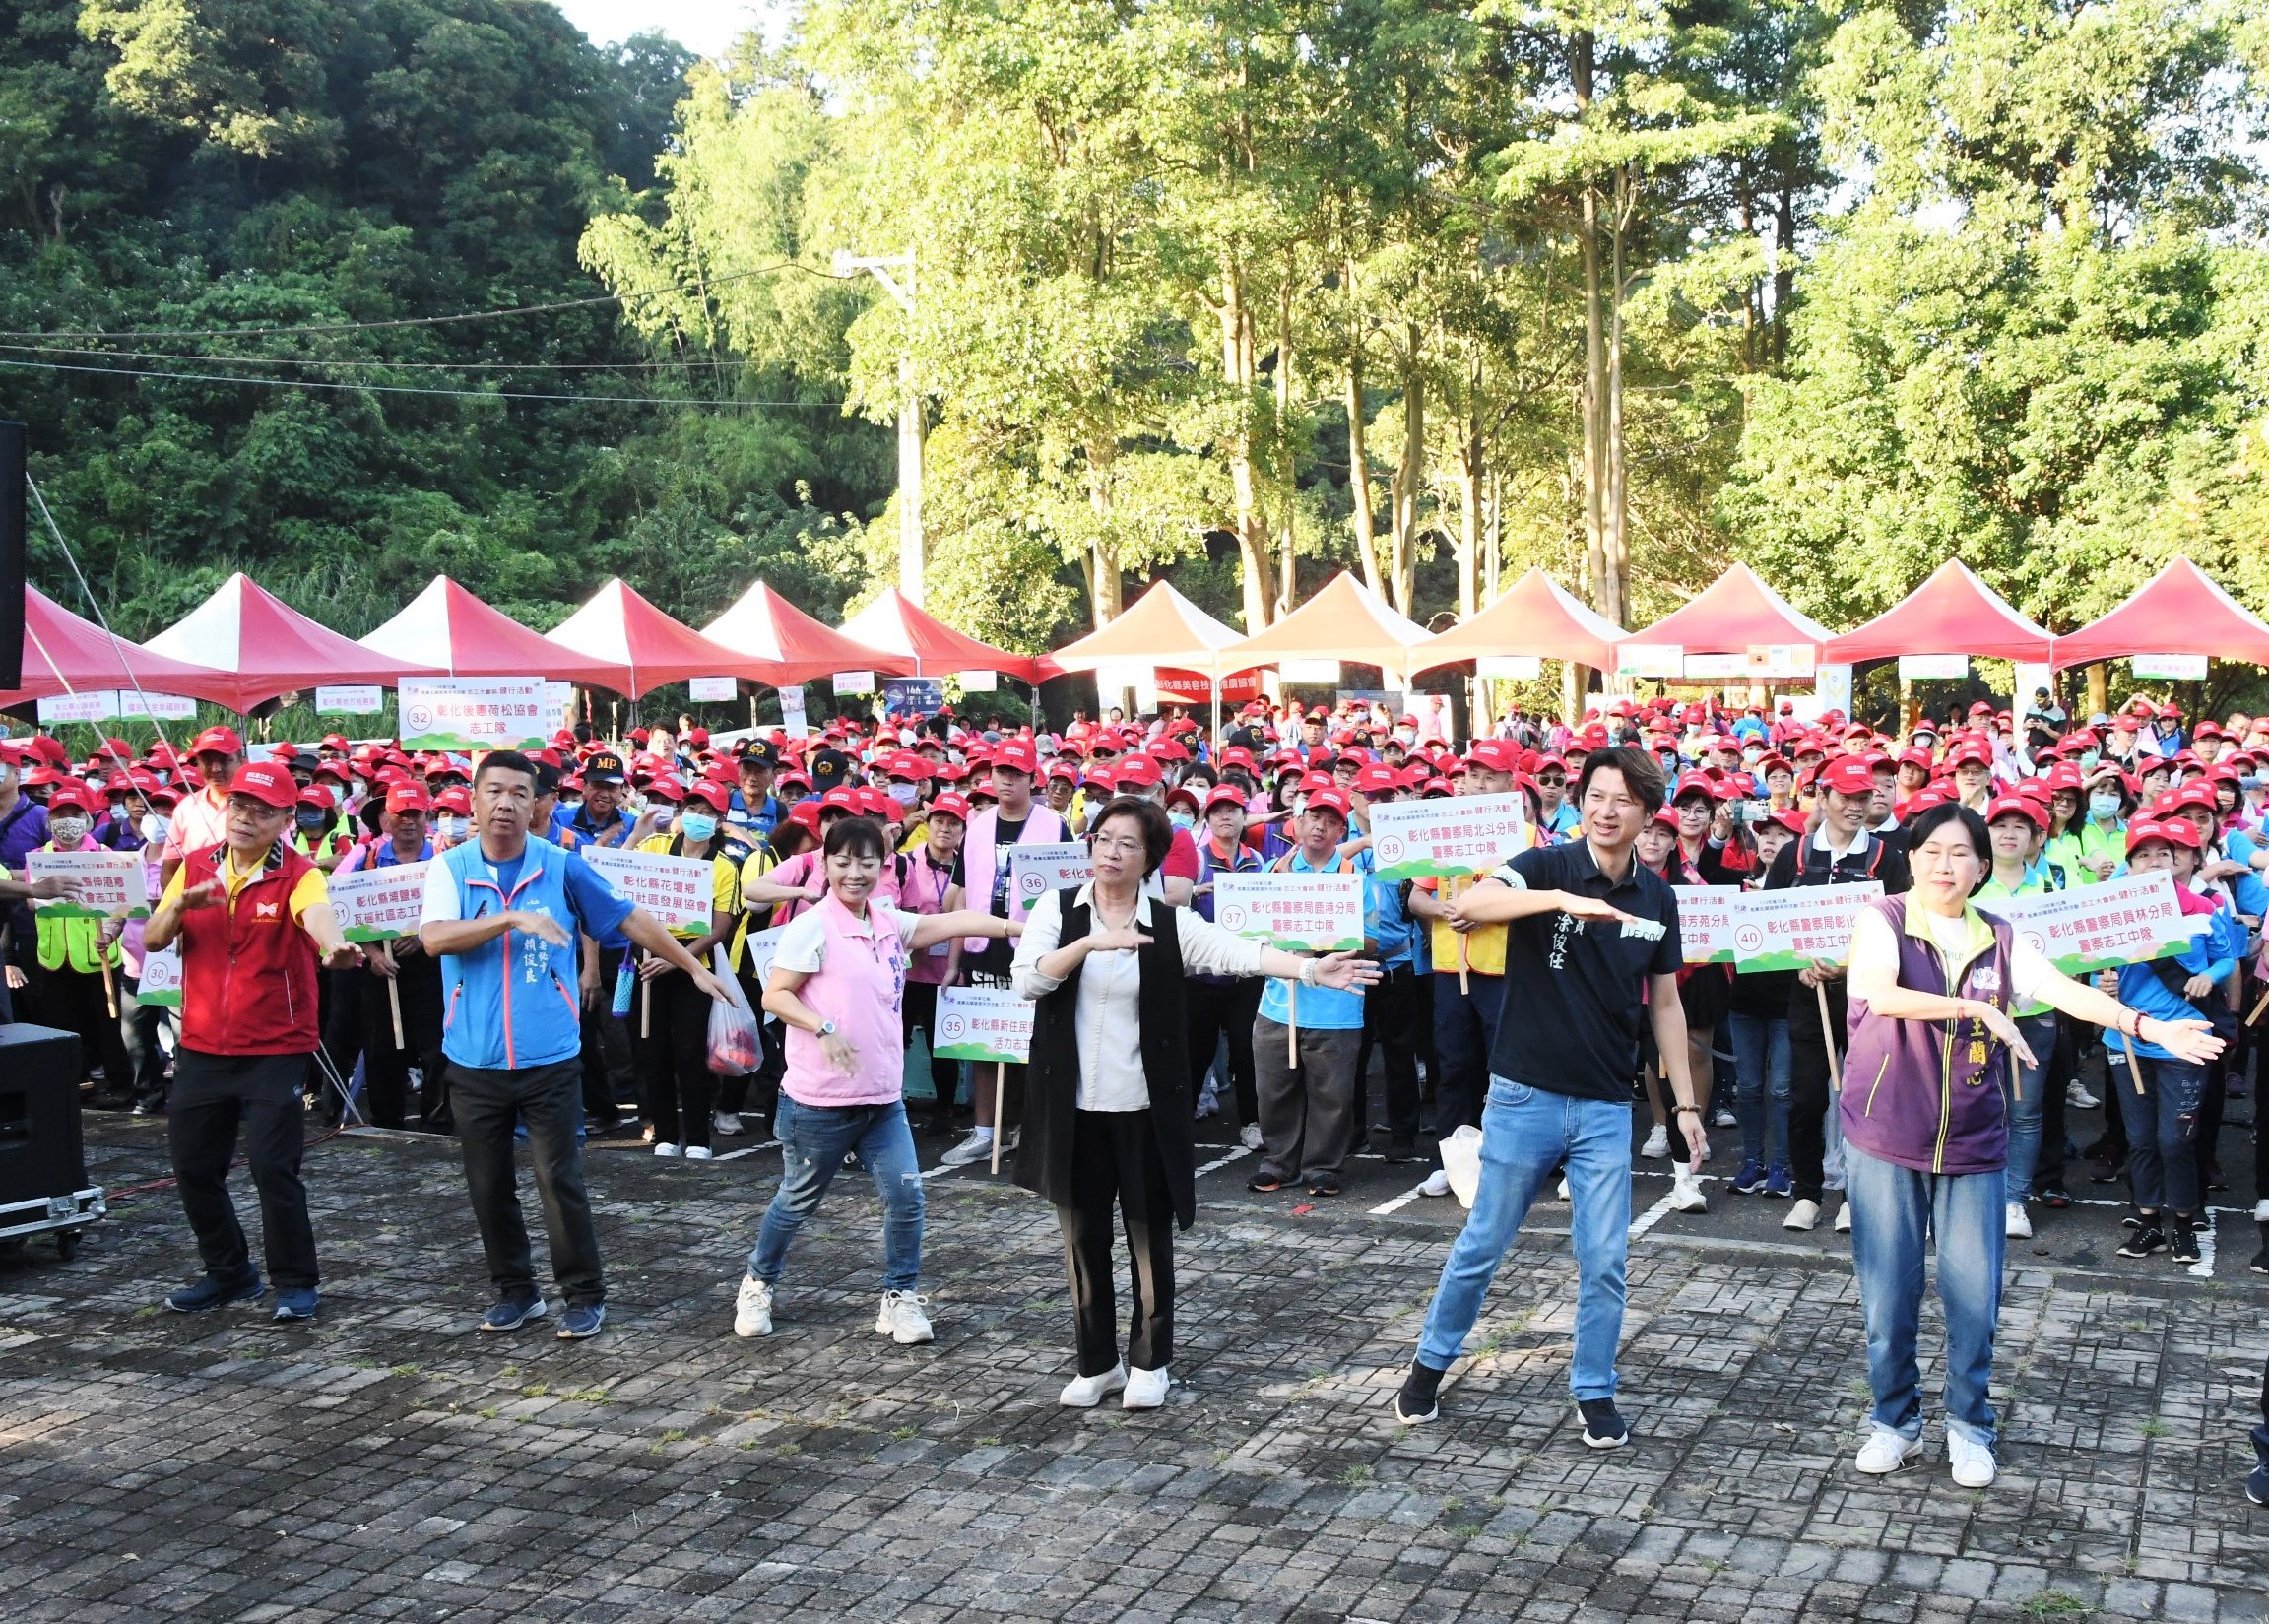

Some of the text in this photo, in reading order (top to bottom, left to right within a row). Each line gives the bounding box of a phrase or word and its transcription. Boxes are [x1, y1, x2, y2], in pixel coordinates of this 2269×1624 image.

[1155, 677, 1257, 691] 彰化縣美容技推廣協會
[412, 712, 427, 724] 32
[469, 722, 507, 735] 志工隊
[596, 758, 617, 770] MP
[1408, 821, 1518, 843] 彰化縣警察局北斗分局
[1383, 843, 1399, 855] 38
[1432, 841, 1498, 859] 警察志工中隊
[623, 875, 696, 895] 彰化縣花壇鄉
[1025, 878, 1042, 888] 36
[618, 888, 708, 913] 口社區發展協會
[1251, 900, 1356, 915] 彰化縣警察局鹿港分局
[1225, 912, 1241, 924] 37
[2048, 902, 2173, 939] 彰化縣警察局員林分局
[1272, 919, 1335, 933] 警察志工中隊
[1549, 913, 1574, 970] 涂俊任
[1740, 932, 1758, 943] 40
[1791, 933, 1852, 951] 警察志工中
[2078, 926, 2154, 953] 警察志工中隊
[150, 968, 164, 979] 30
[945, 1021, 961, 1032] 35
[994, 1037, 1031, 1051] 活力志工
[1966, 1016, 1987, 1086] 王蘭心
